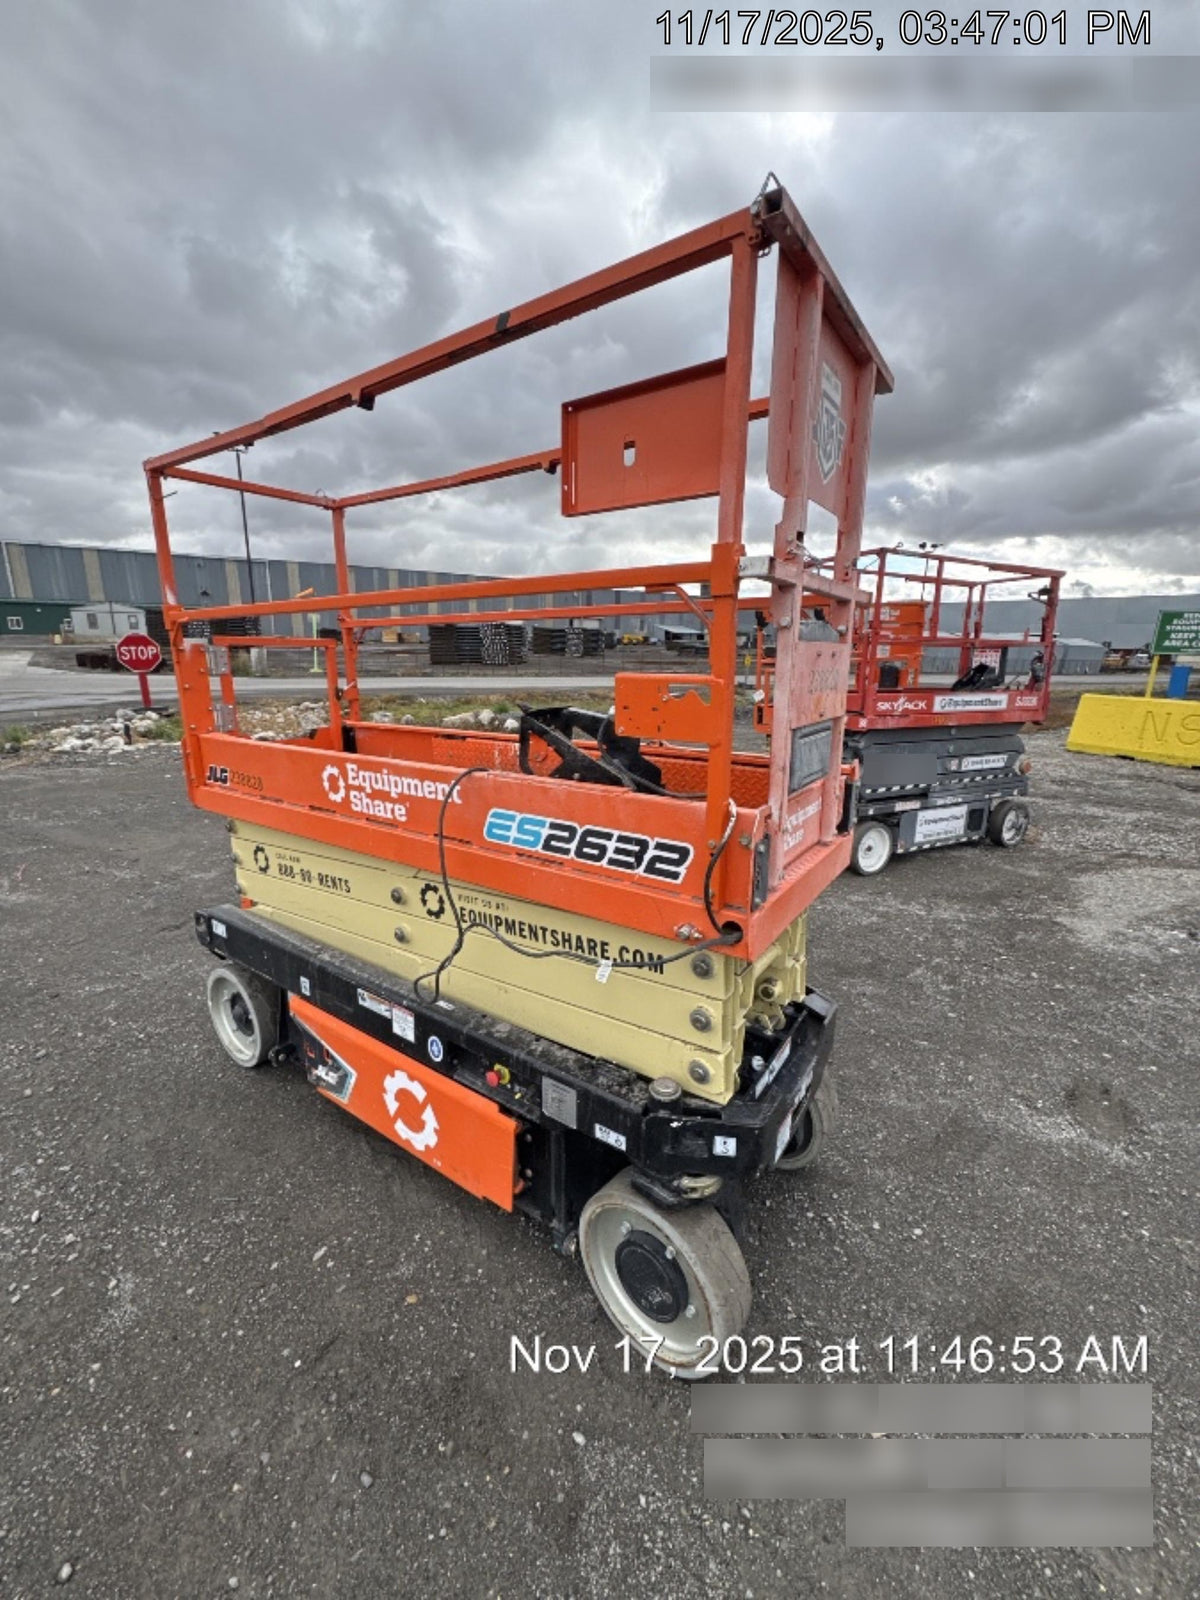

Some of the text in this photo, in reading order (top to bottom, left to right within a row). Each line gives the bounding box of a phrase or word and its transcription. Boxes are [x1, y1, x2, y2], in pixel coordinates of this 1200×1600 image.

[120, 646, 157, 660] STOP
[876, 696, 927, 712] SKYJACK
[206, 764, 229, 785] JLG
[346, 763, 462, 804] Equipment
[350, 791, 408, 822] Share
[483, 807, 694, 884] ES2632
